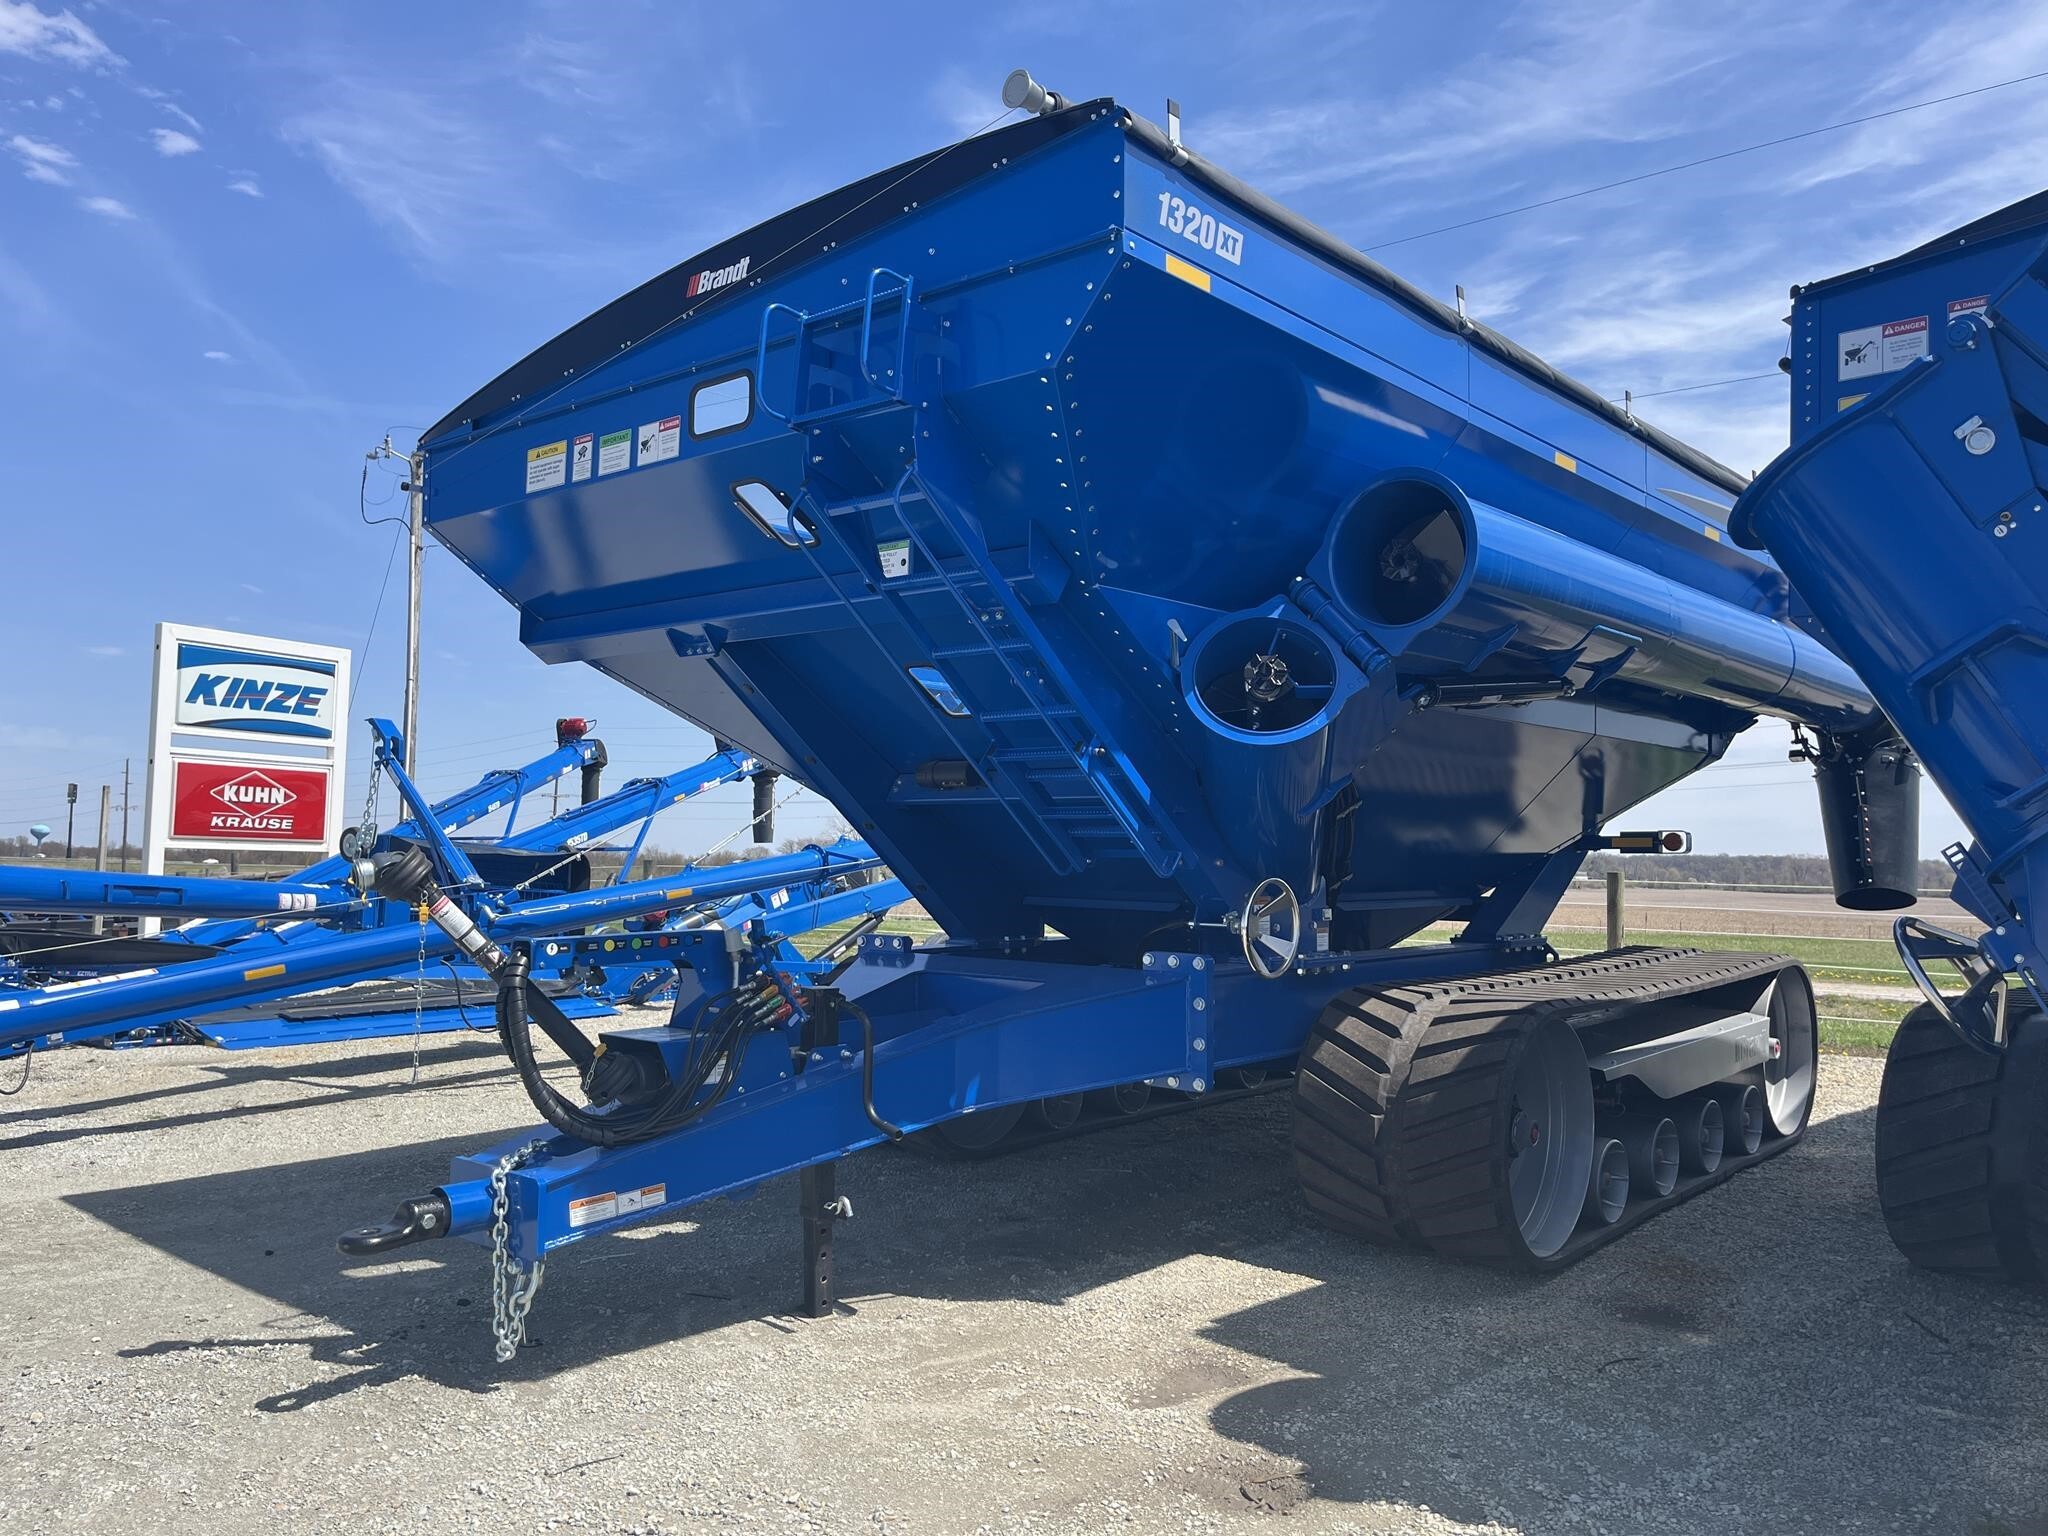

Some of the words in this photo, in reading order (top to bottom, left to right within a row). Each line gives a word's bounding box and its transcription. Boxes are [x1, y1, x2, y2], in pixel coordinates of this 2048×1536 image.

[1158, 191, 1216, 250] 1320
[696, 256, 750, 294] Brandt
[1962, 298, 1987, 309] DANGE
[1894, 320, 1926, 333] DANGER
[541, 447, 559, 457] CAUTION
[184, 673, 328, 717] KINZE
[223, 784, 286, 804] KUHN
[210, 815, 294, 830] KRAUSE
